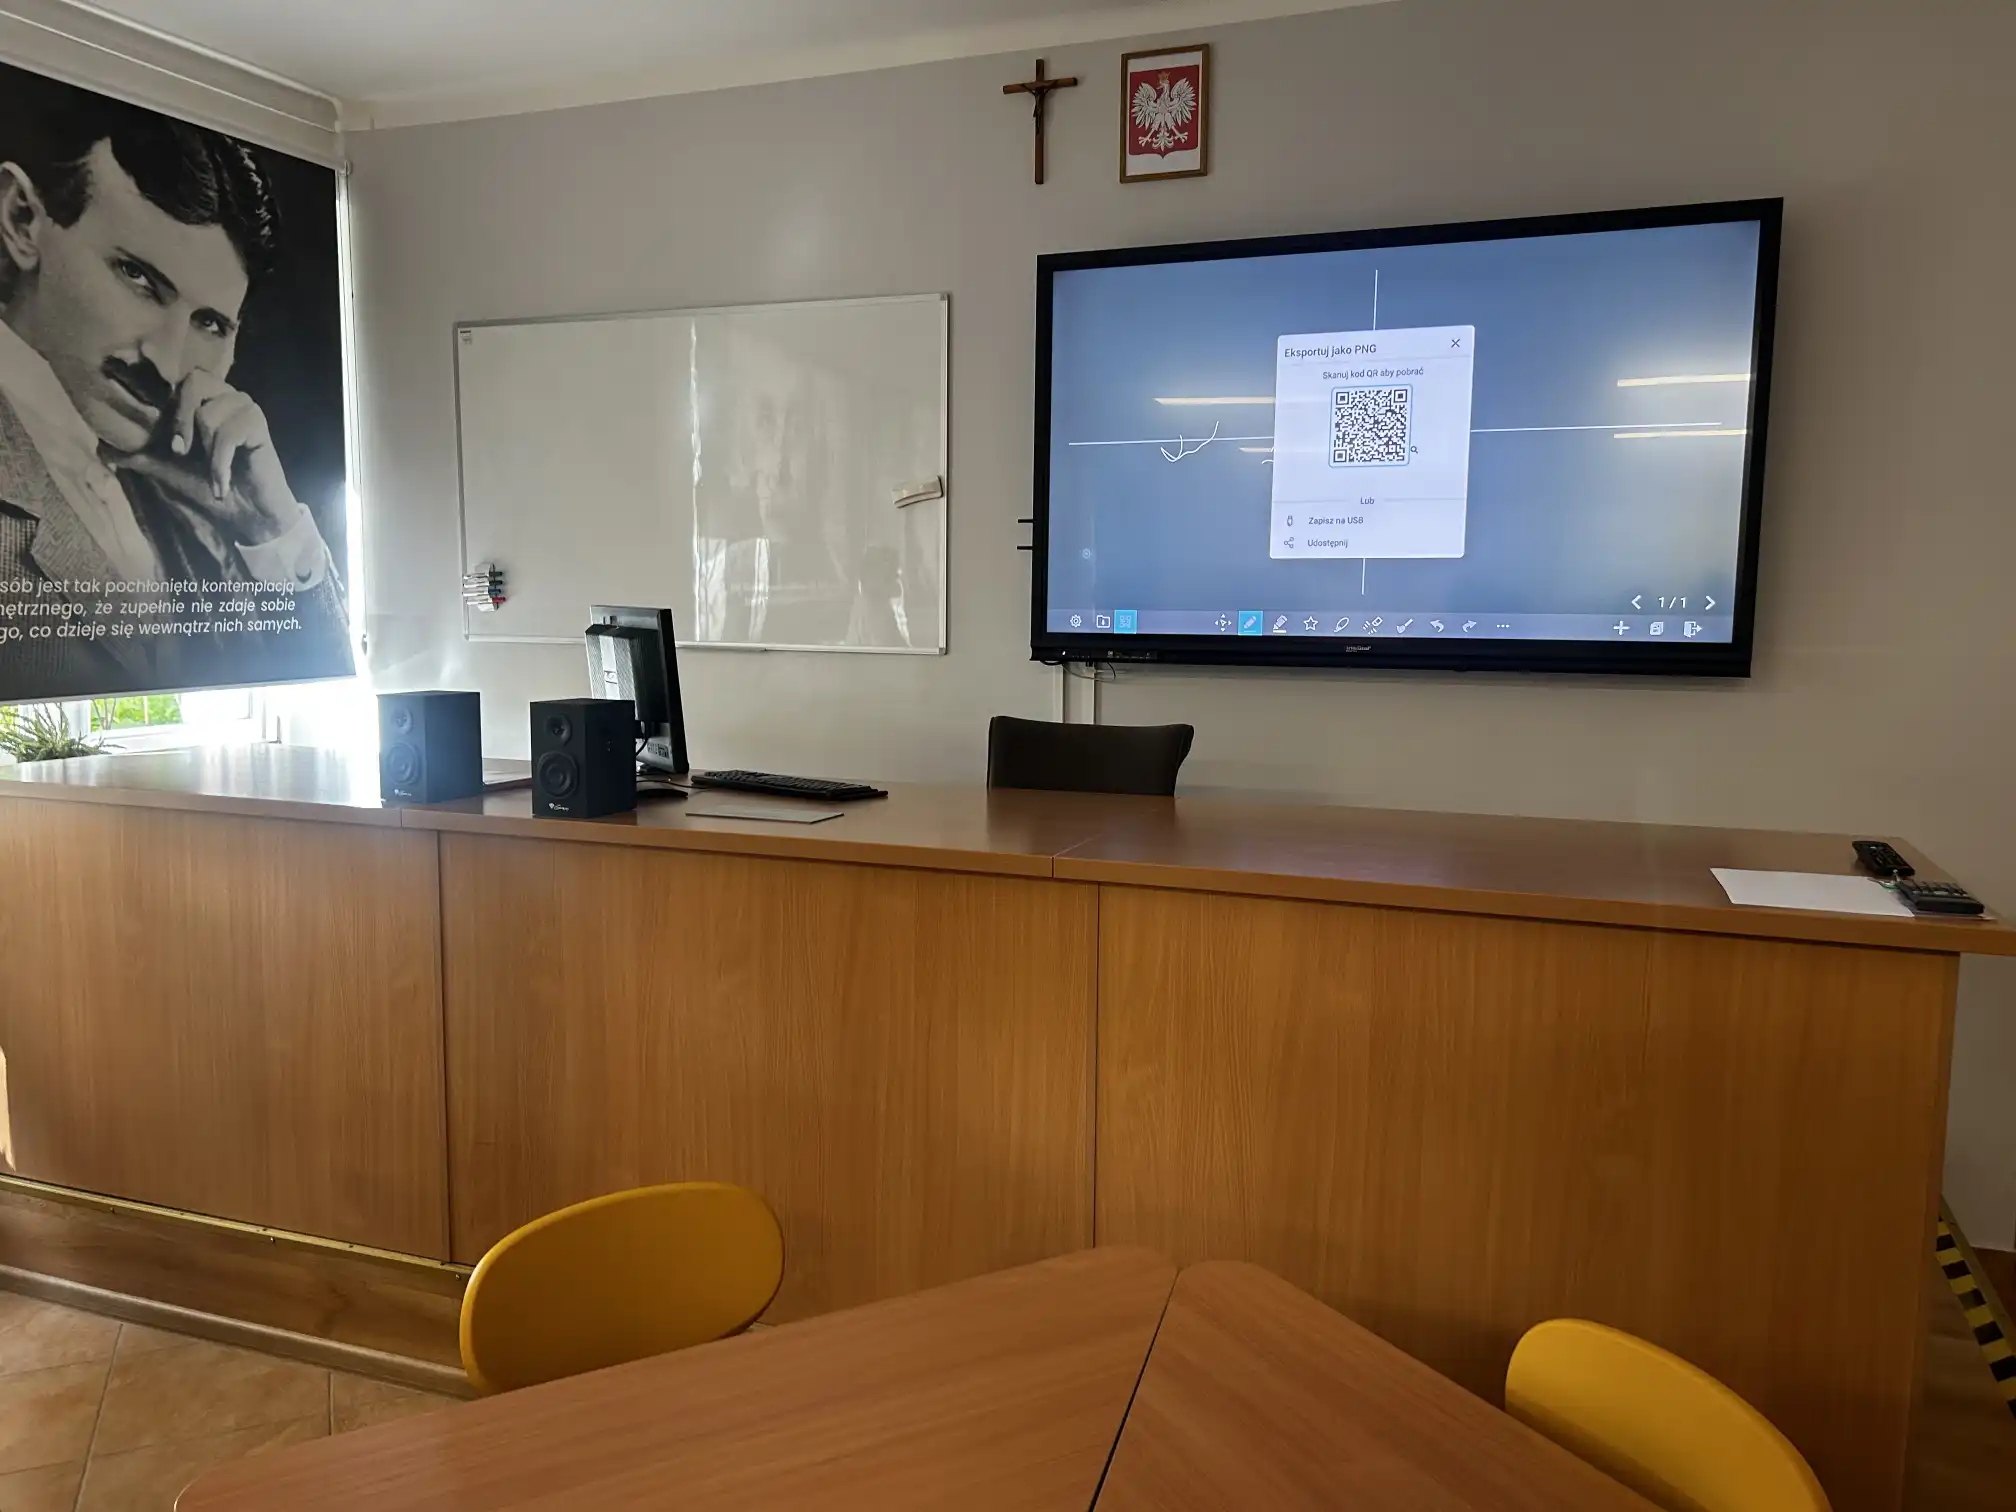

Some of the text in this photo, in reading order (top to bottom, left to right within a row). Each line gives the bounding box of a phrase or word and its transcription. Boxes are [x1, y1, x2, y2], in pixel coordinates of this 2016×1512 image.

[1284, 344, 1377, 359] Eksportuj jako PNG
[1322, 366, 1424, 380] Skanuj kod QR aby pobrać
[1360, 496, 1375, 505] Lub
[1308, 516, 1334, 525] Zapisz
[1347, 516, 1364, 525] USB
[1307, 539, 1349, 549] Udostępnij
[36, 577, 70, 598] jest
[74, 578, 101, 593] tak
[104, 577, 198, 598] pochłonięta
[201, 578, 294, 597] kontemplacją
[94, 599, 113, 615] że
[119, 598, 185, 619] zupełnie
[191, 598, 213, 613] nie
[218, 598, 256, 617] zdaje
[260, 597, 296, 612] sobie
[29, 625, 52, 639] co
[56, 621, 107, 641] dzieje
[111, 620, 134, 639] się
[138, 619, 211, 637] wewnątrz
[214, 617, 243, 633] nich
[246, 616, 303, 635] samych.
